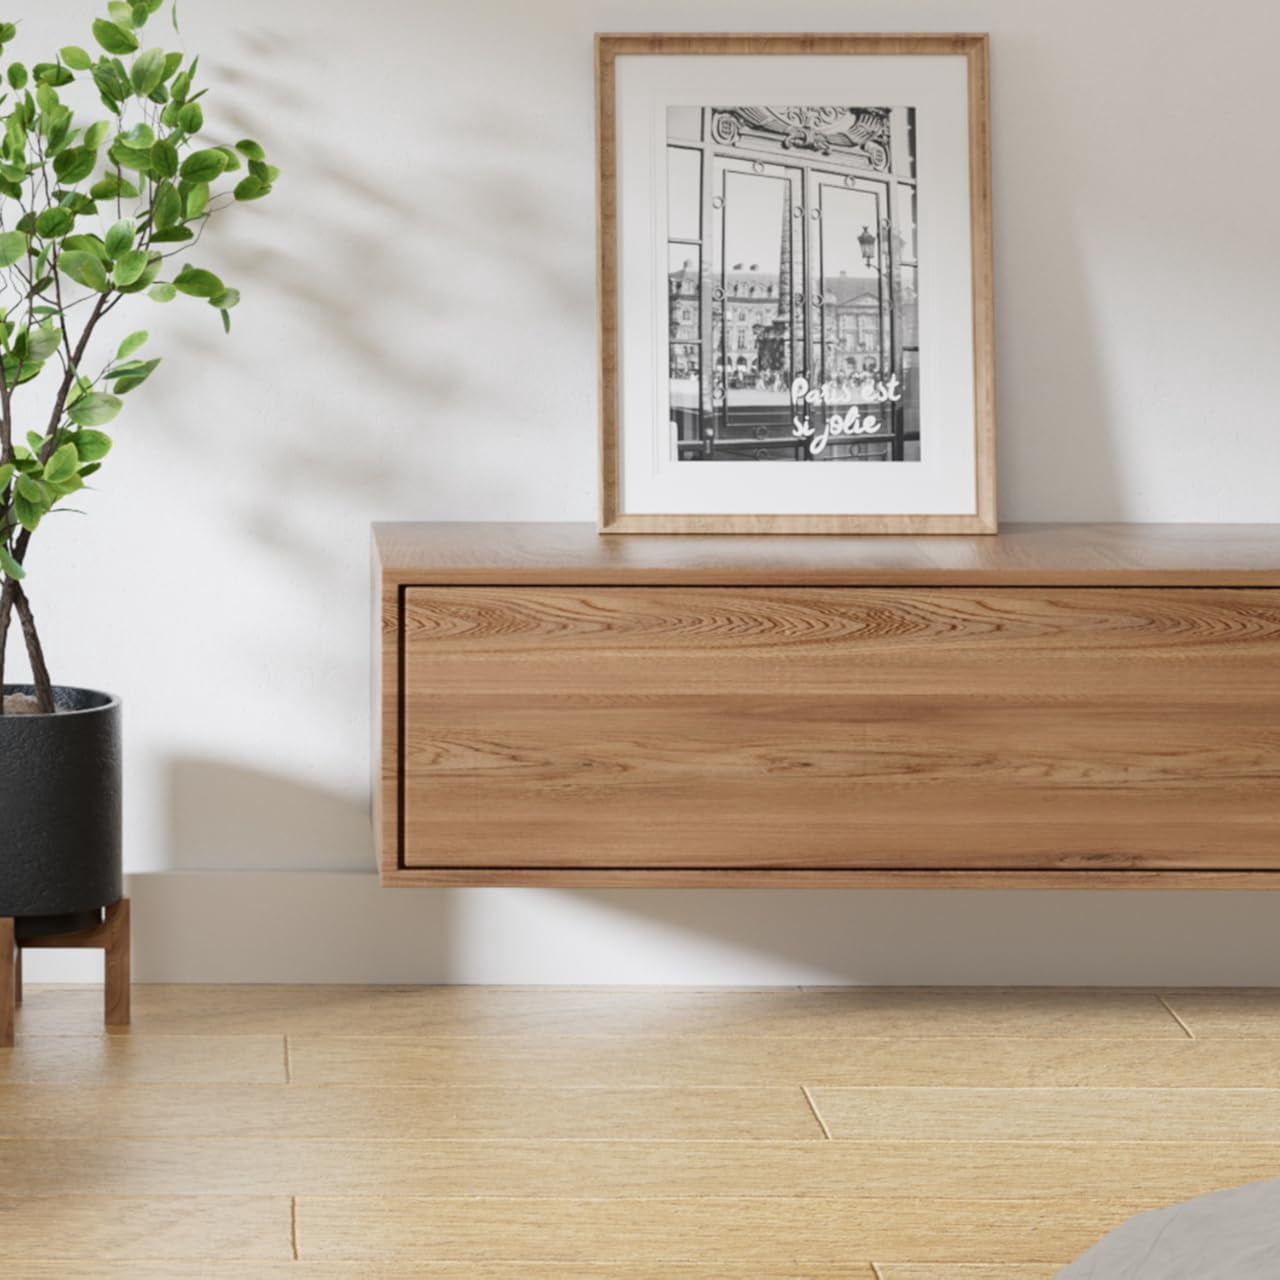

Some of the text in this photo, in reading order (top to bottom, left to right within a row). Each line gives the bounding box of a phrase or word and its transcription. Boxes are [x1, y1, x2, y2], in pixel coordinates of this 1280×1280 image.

[791, 373, 901, 405] Paris est
[792, 406, 883, 455] si jolie
